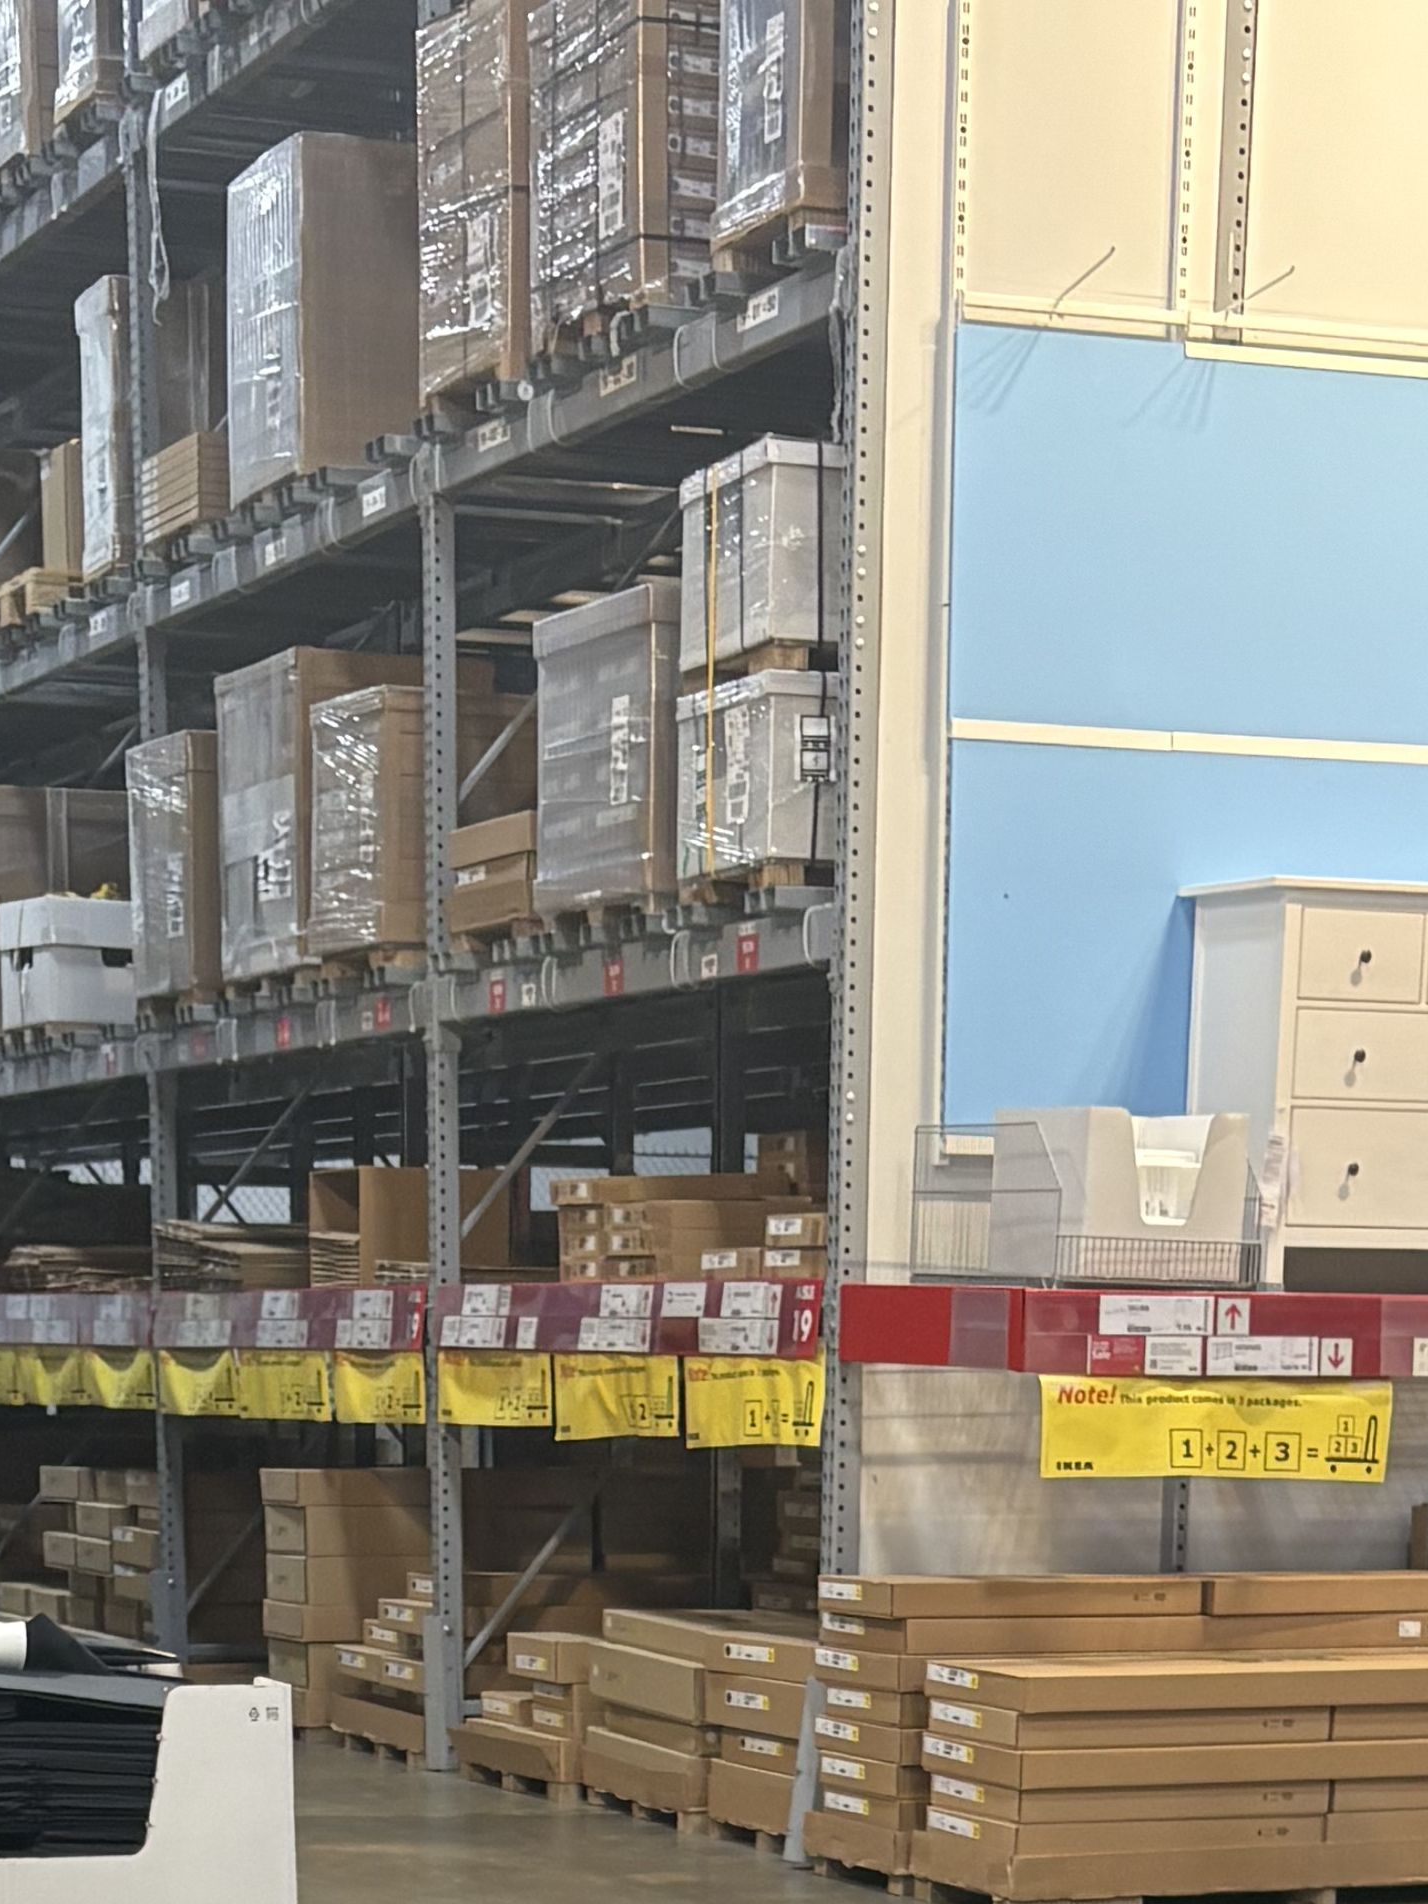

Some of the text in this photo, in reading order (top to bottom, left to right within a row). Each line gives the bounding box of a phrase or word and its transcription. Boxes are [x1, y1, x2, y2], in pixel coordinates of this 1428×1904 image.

[792, 1309, 813, 1342] 19
[1057, 1385, 1117, 1404] Note!
[1120, 1393, 1143, 1405] This
[1146, 1393, 1190, 1407] product
[1191, 1395, 1223, 1405] comes
[1246, 1395, 1302, 1408] packages.
[1181, 1439, 1194, 1459] 1
[1225, 1440, 1238, 1460] 2
[1274, 1442, 1290, 1462] 3
[1056, 1461, 1094, 1471] IKEA
